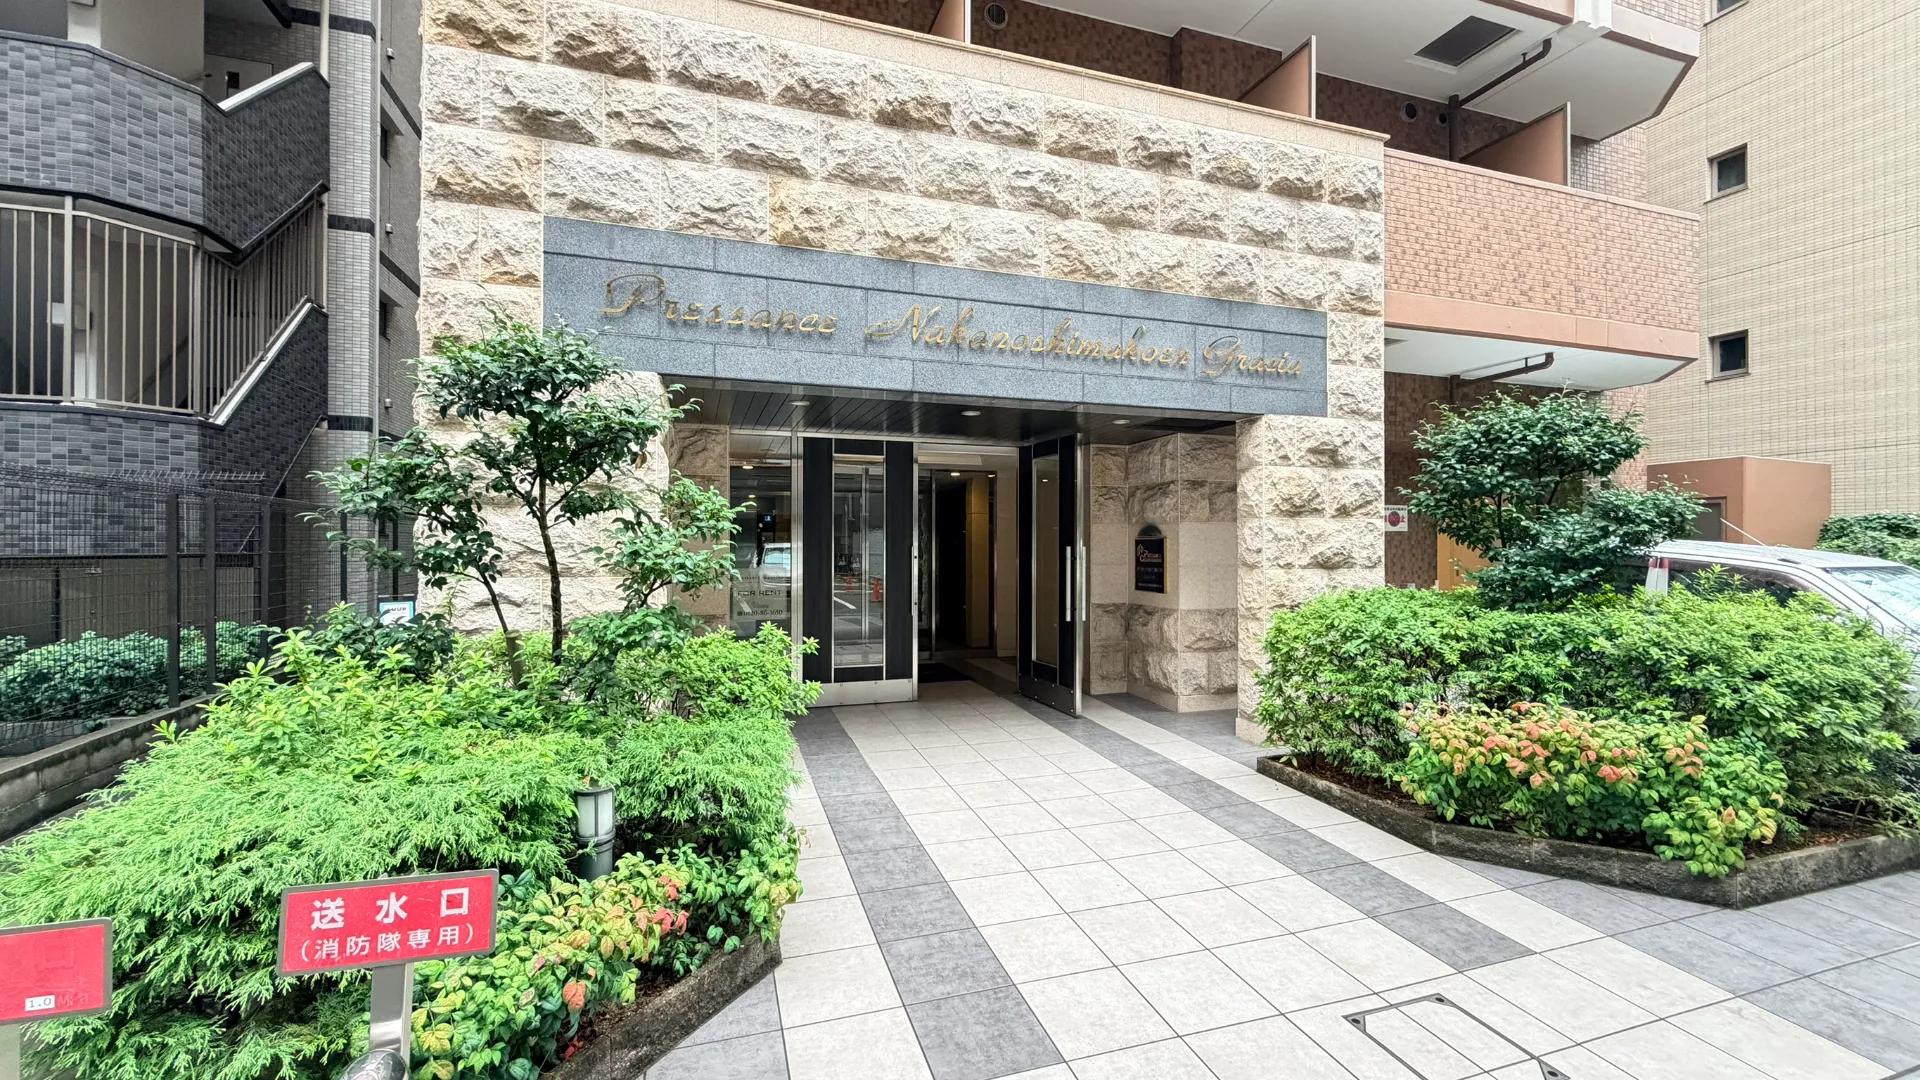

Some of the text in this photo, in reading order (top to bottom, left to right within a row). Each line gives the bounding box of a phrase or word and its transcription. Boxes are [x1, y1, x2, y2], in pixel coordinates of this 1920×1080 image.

[600, 273, 838, 334] Pressance
[864, 303, 1191, 366] Nakanoshimakoen
[29, 997, 52, 1008] 1.0
